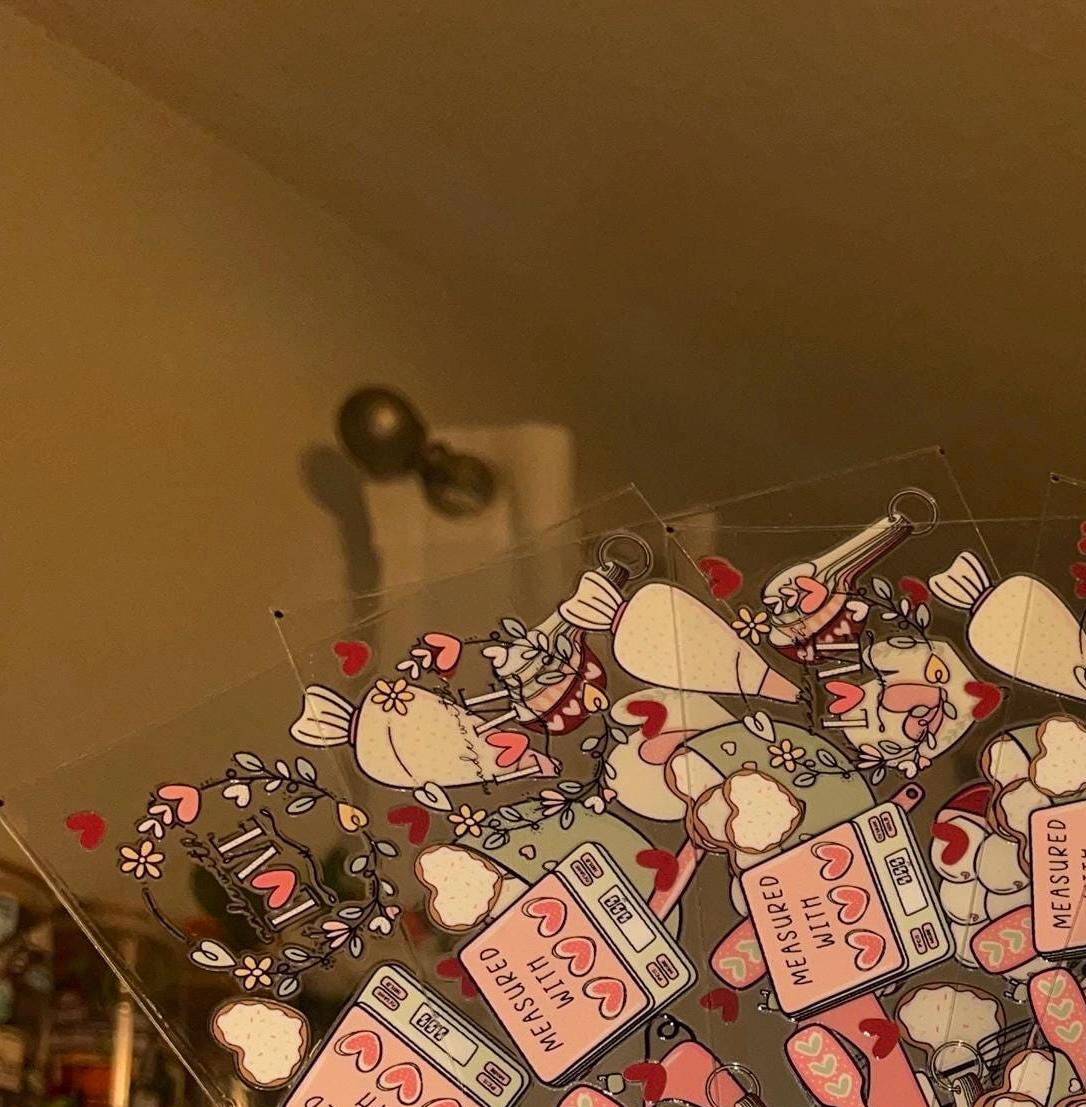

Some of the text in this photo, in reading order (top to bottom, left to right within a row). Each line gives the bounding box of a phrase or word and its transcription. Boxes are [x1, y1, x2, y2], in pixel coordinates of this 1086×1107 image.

[800, 896, 835, 949] WITH
[1047, 819, 1072, 929] MEASURED
[526, 956, 575, 1009] WITH
[760, 876, 813, 985] MEASURED
[479, 948, 564, 1052] MEASURED
